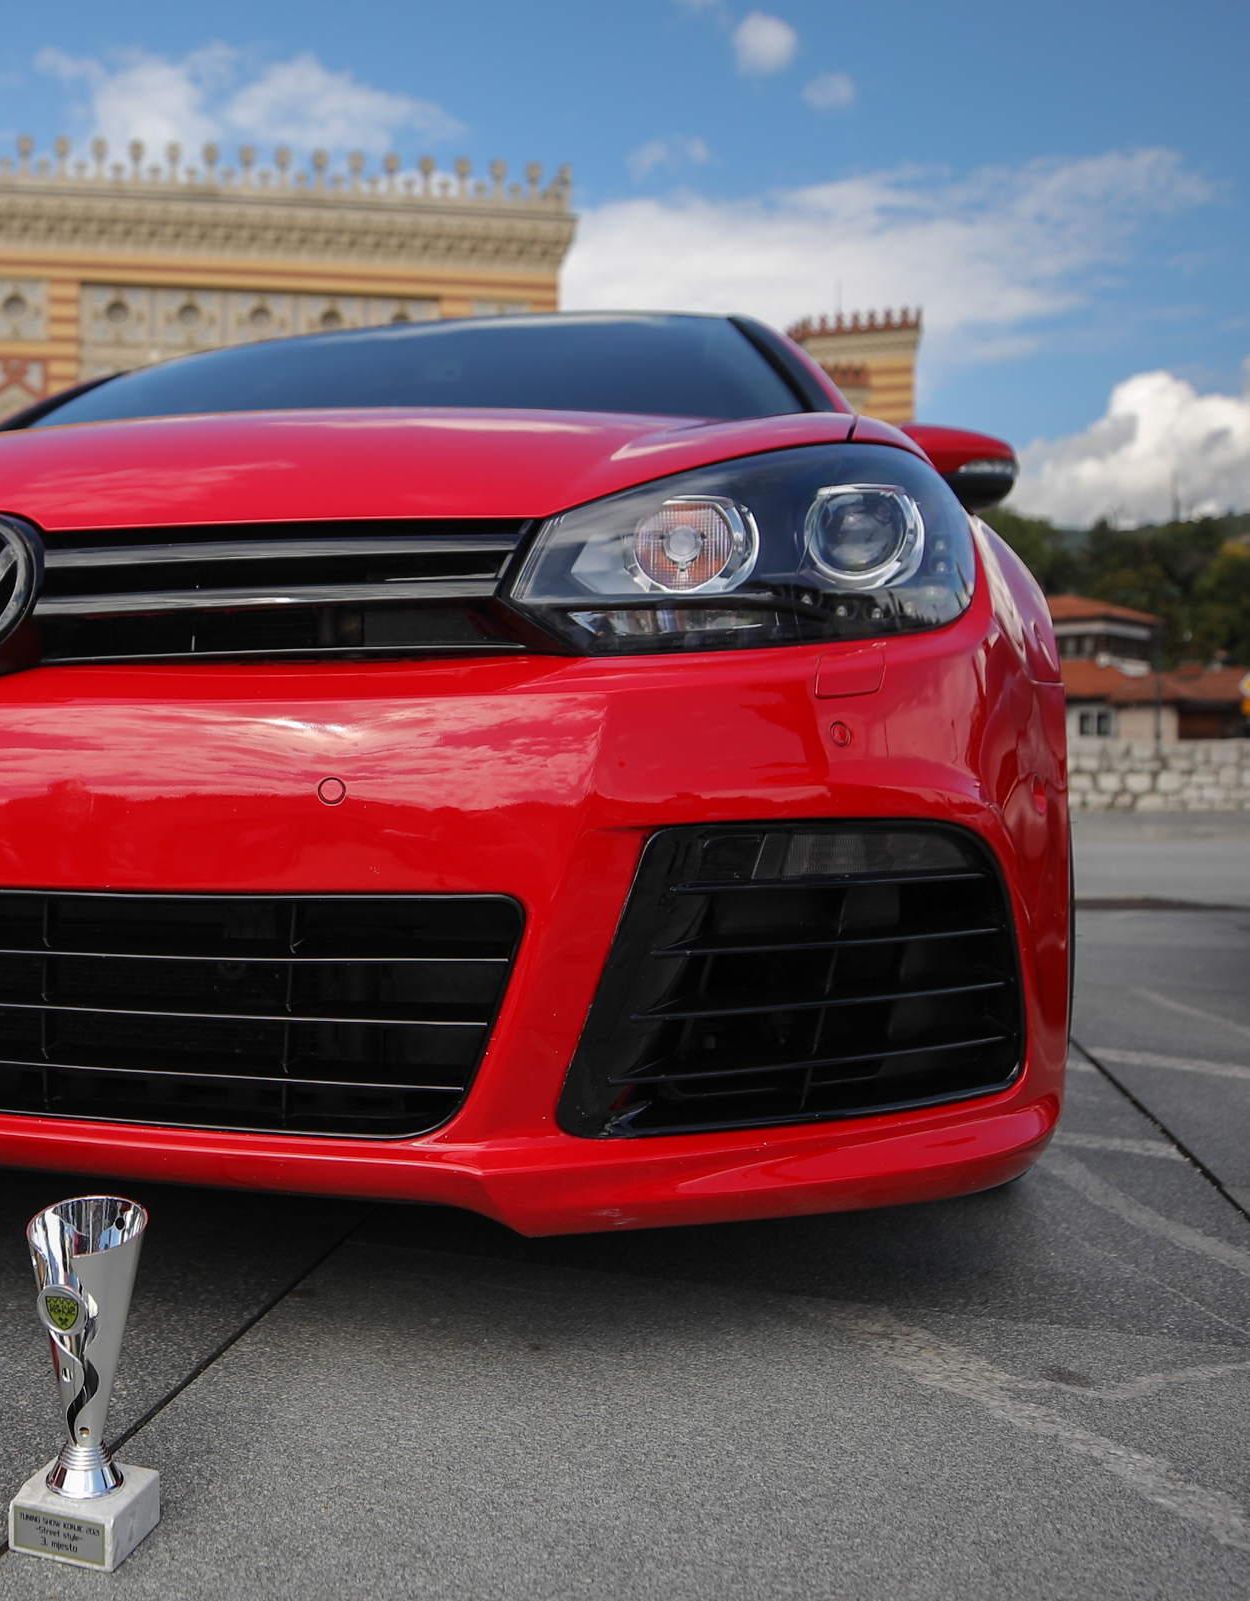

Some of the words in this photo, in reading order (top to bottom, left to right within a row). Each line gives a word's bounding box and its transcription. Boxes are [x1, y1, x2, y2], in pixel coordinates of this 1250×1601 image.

[19, 1512, 41, 1524] TUNING
[42, 1517, 61, 1528] SHOW
[63, 1522, 84, 1533] KONJIC
[40, 1536, 48, 1547] 3.
[51, 1540, 78, 1553] mjesto
